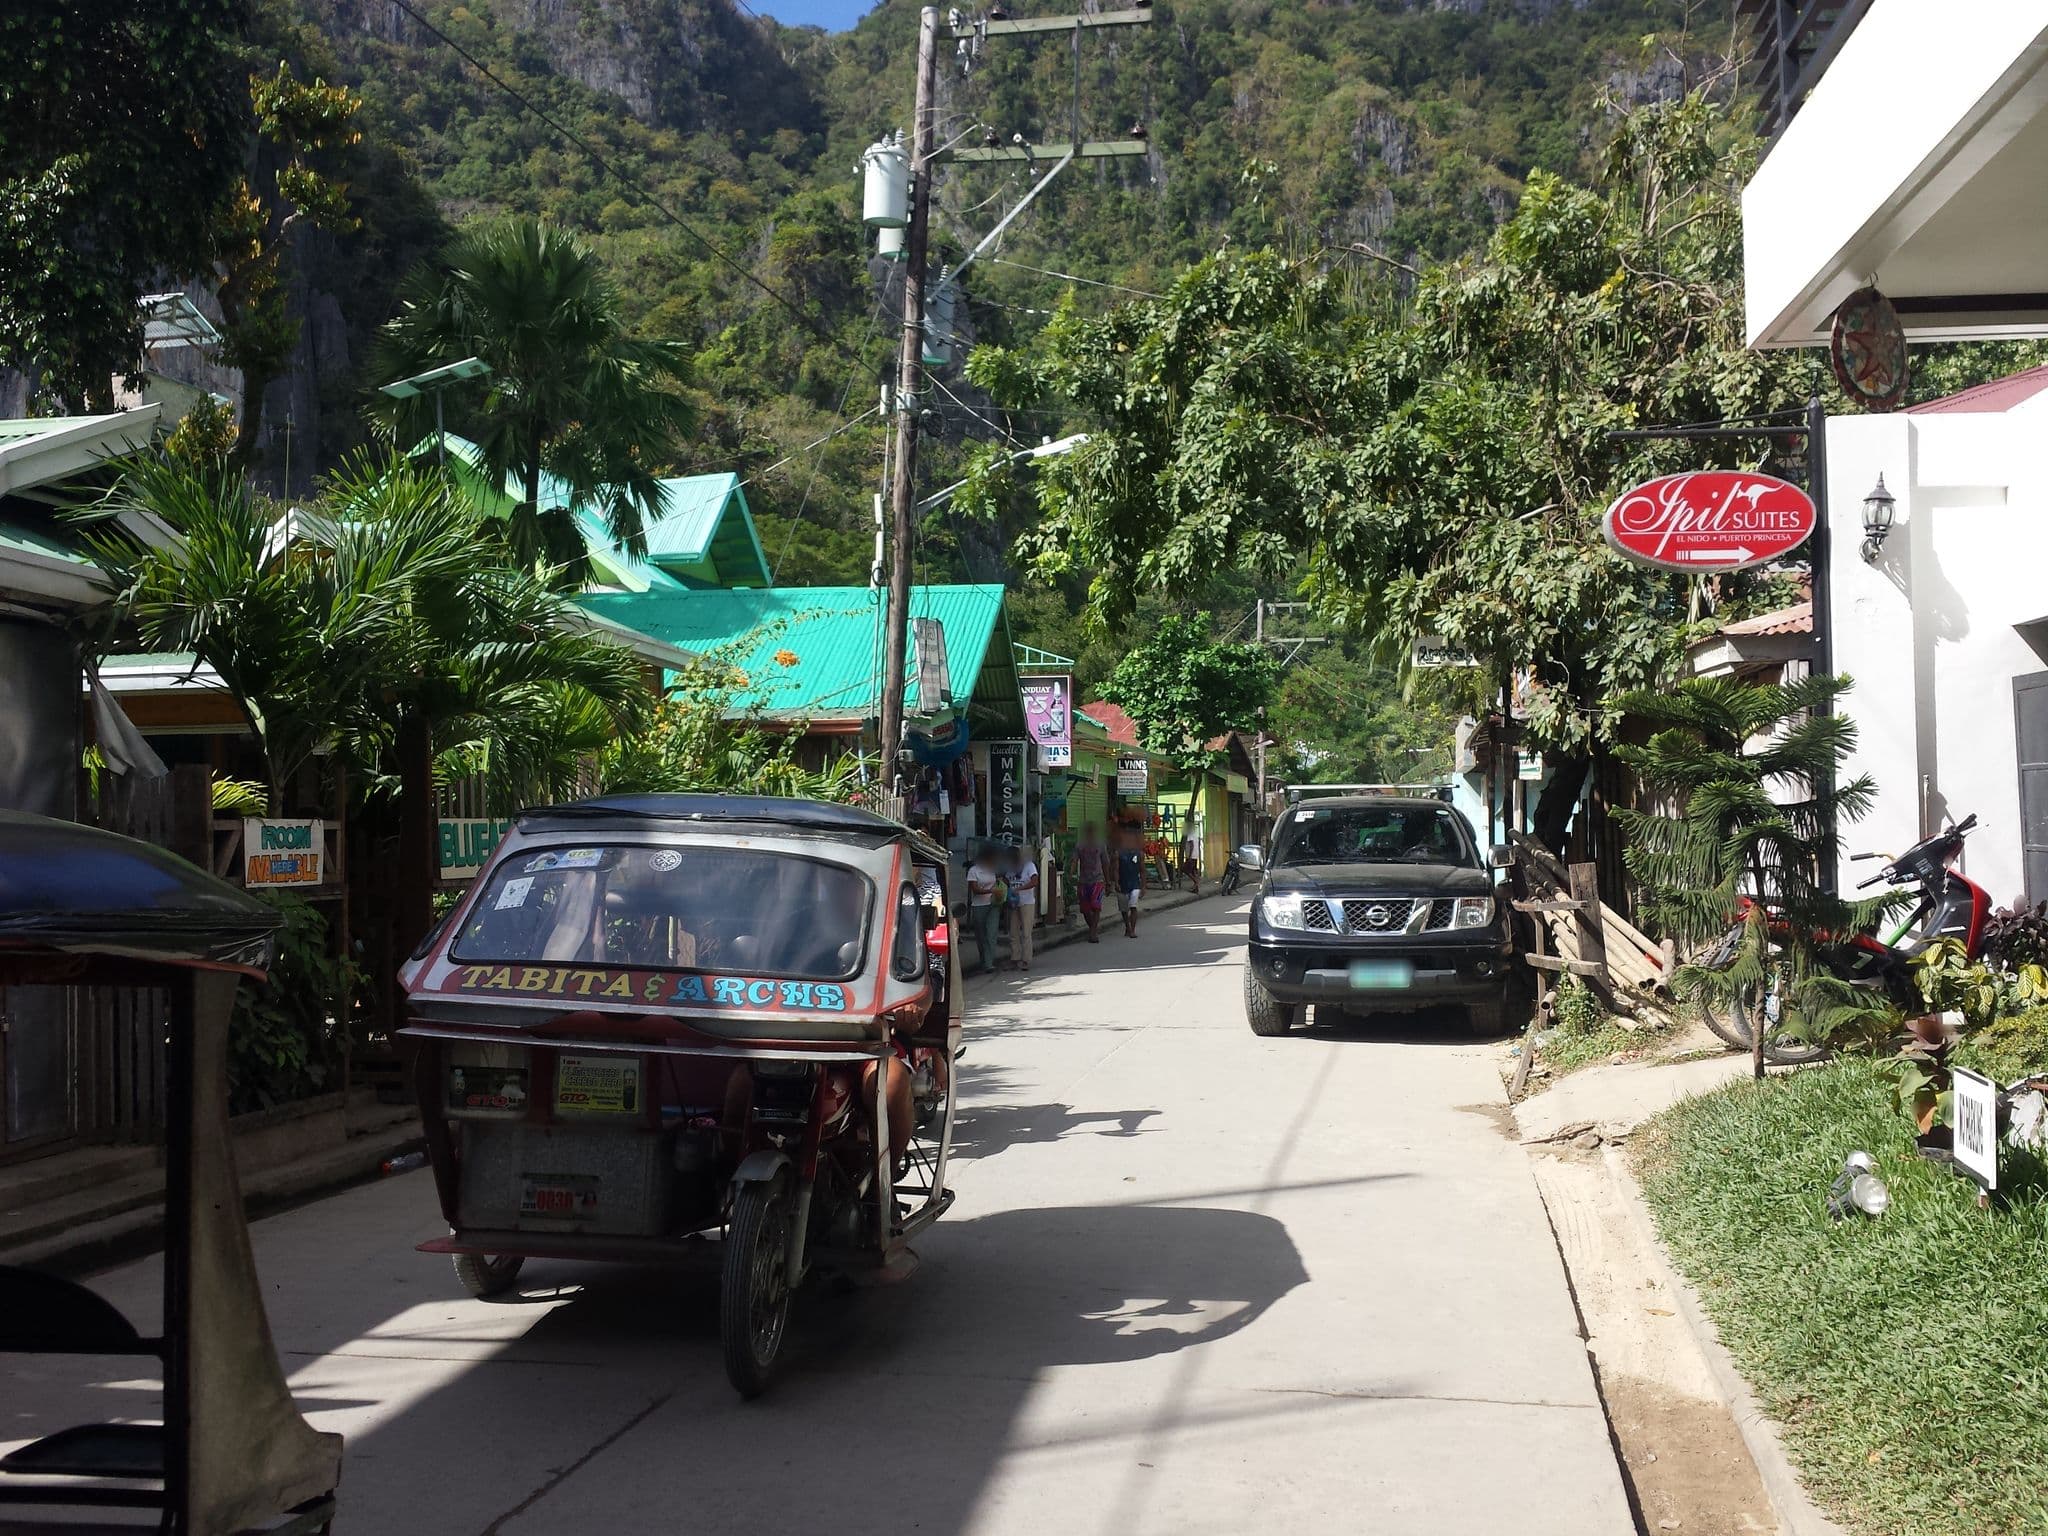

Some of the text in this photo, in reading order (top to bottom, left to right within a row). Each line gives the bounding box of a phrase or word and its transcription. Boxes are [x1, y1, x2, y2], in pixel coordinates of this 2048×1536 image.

[1732, 511, 1801, 529] SUITES
[1676, 533, 1792, 543] EL NIDO PUERTO PRINCESA
[261, 826, 311, 849] ROOM
[461, 966, 634, 997] TABITA
[669, 975, 846, 1012] ARCHE
